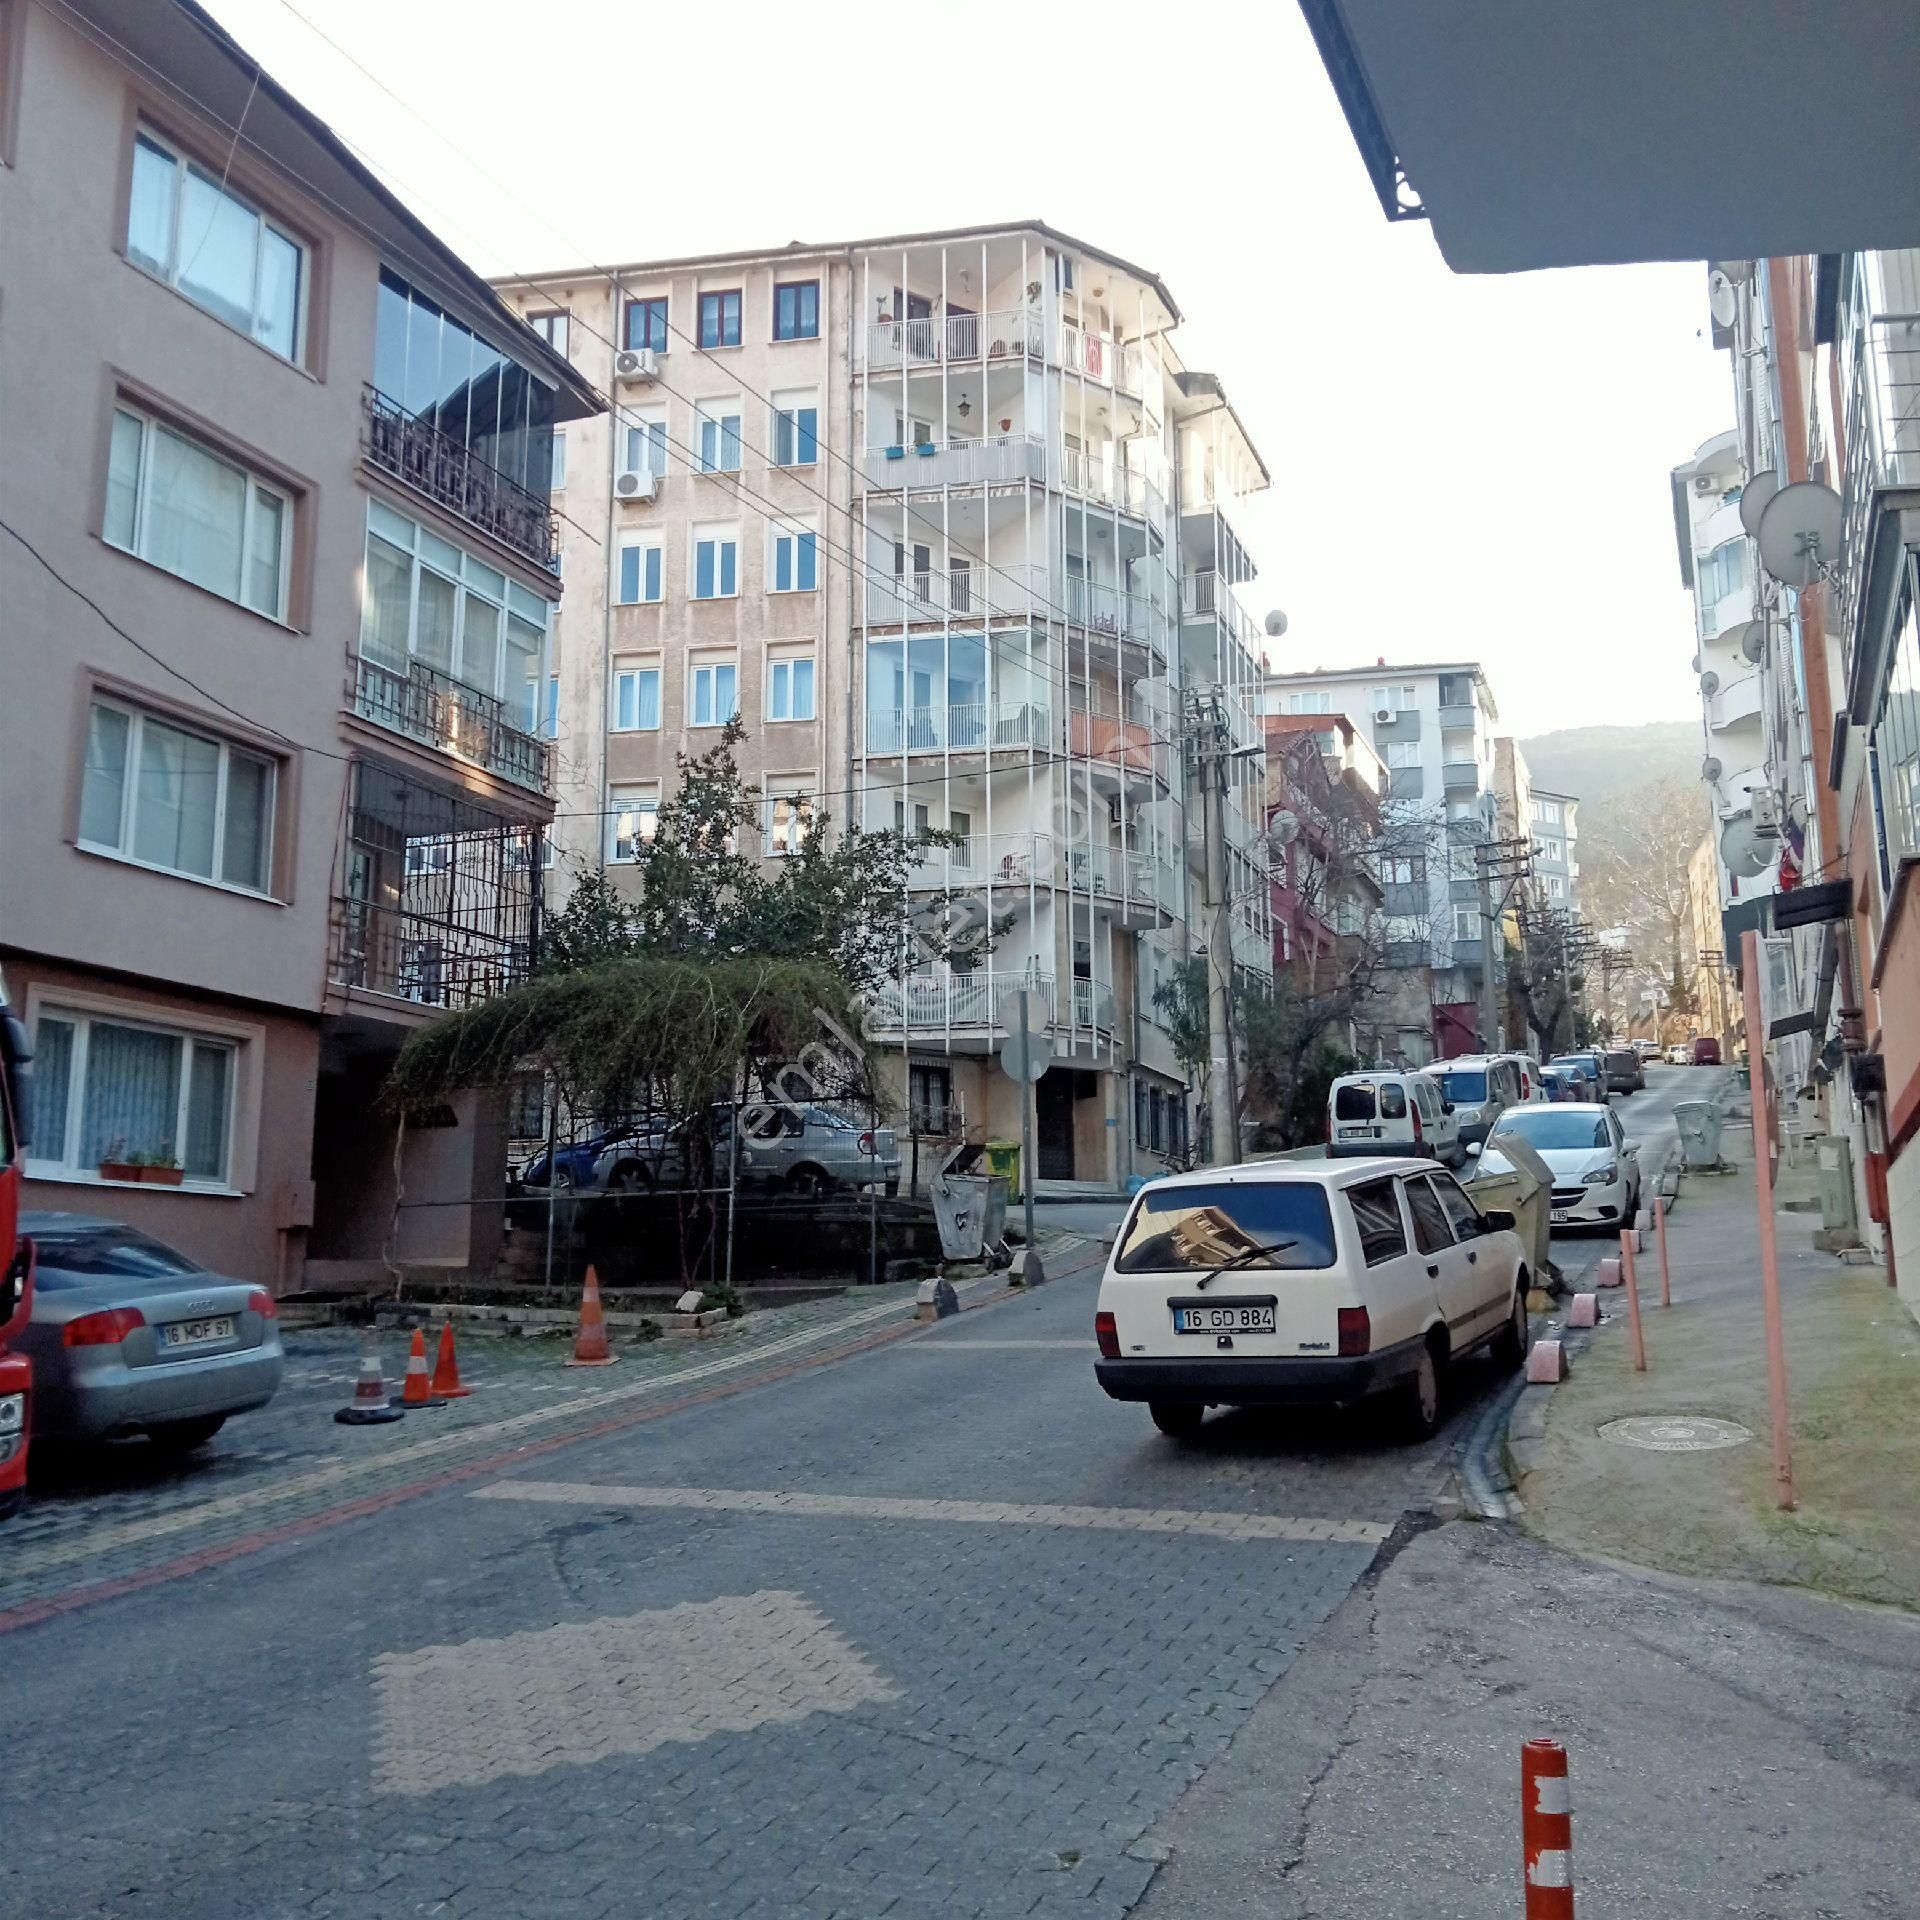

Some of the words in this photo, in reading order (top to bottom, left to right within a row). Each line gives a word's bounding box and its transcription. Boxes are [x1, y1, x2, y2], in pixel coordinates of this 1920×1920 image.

[1185, 1311, 1202, 1327] 16
[1211, 1310, 1234, 1326] GD
[1241, 1309, 1271, 1326] 884
[165, 1327, 179, 1343] 16
